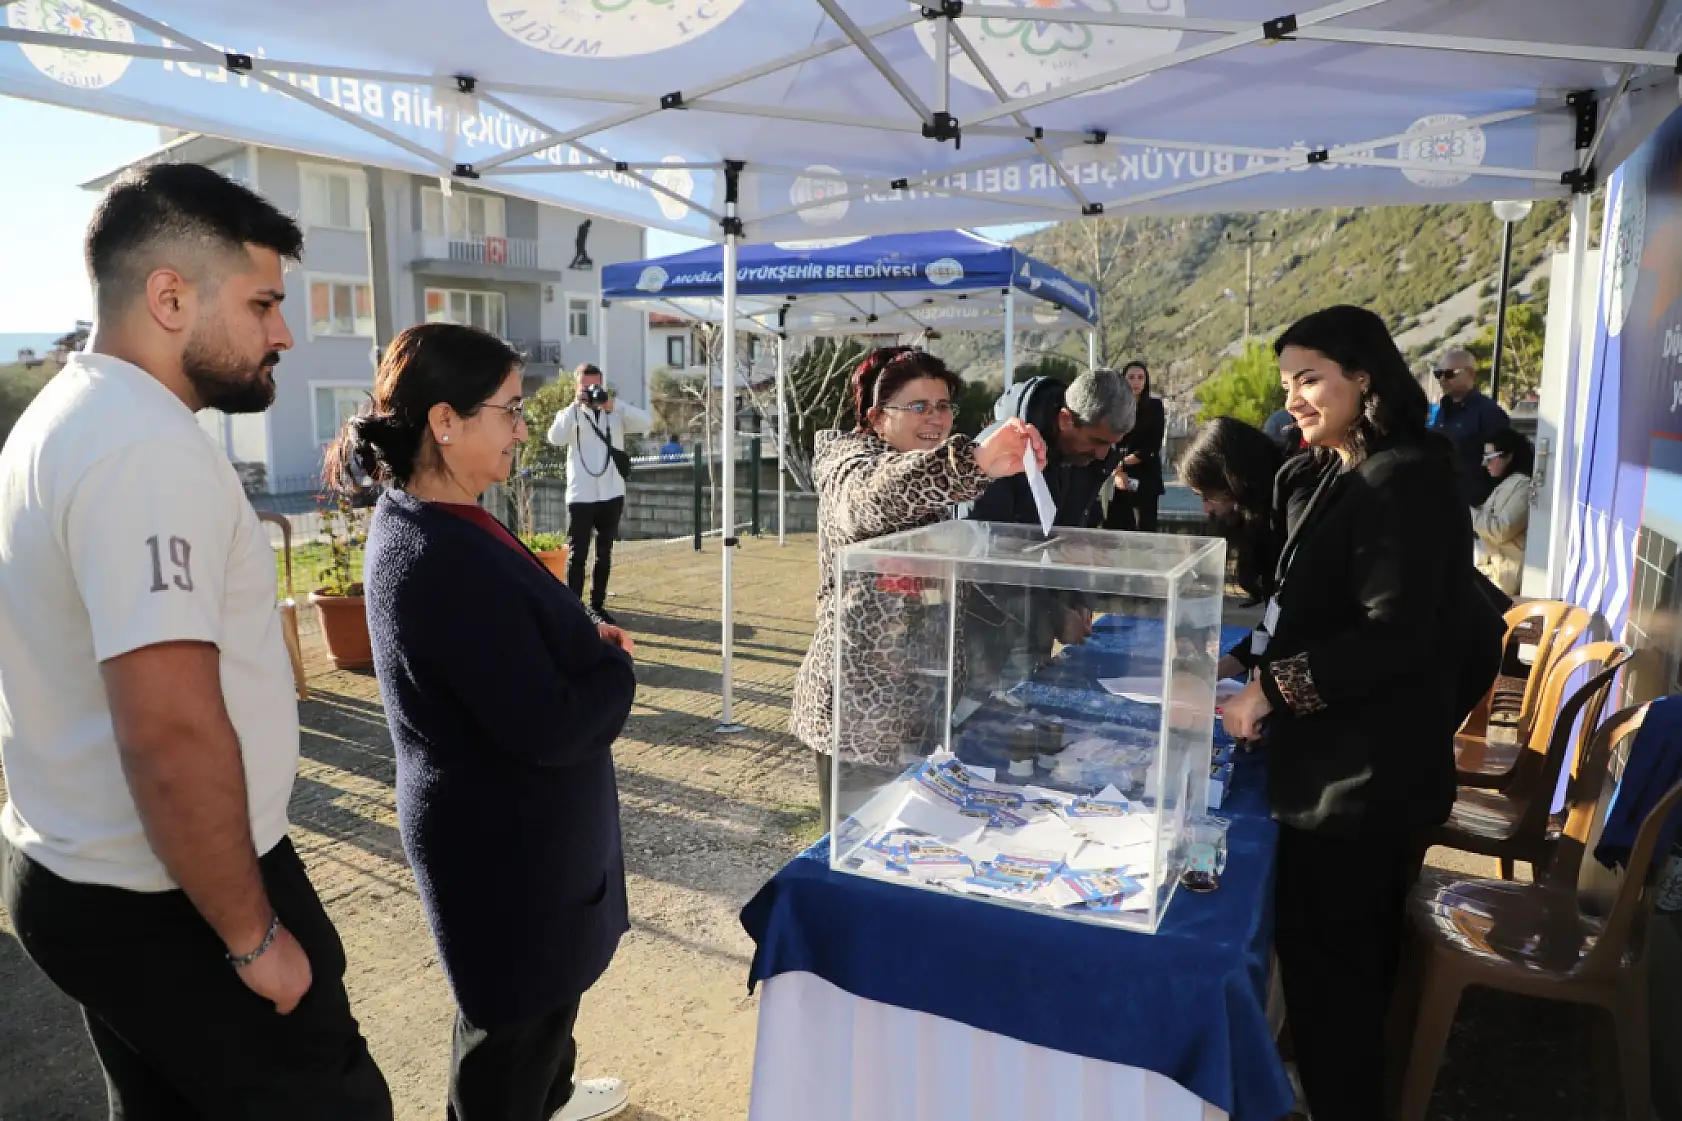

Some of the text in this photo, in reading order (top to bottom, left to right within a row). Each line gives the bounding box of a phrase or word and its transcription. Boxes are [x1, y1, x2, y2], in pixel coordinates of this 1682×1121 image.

[736, 263, 823, 283] ÜYÜKŞEHİR
[826, 259, 918, 279] BELEDİYESİ
[146, 535, 193, 593] 19
